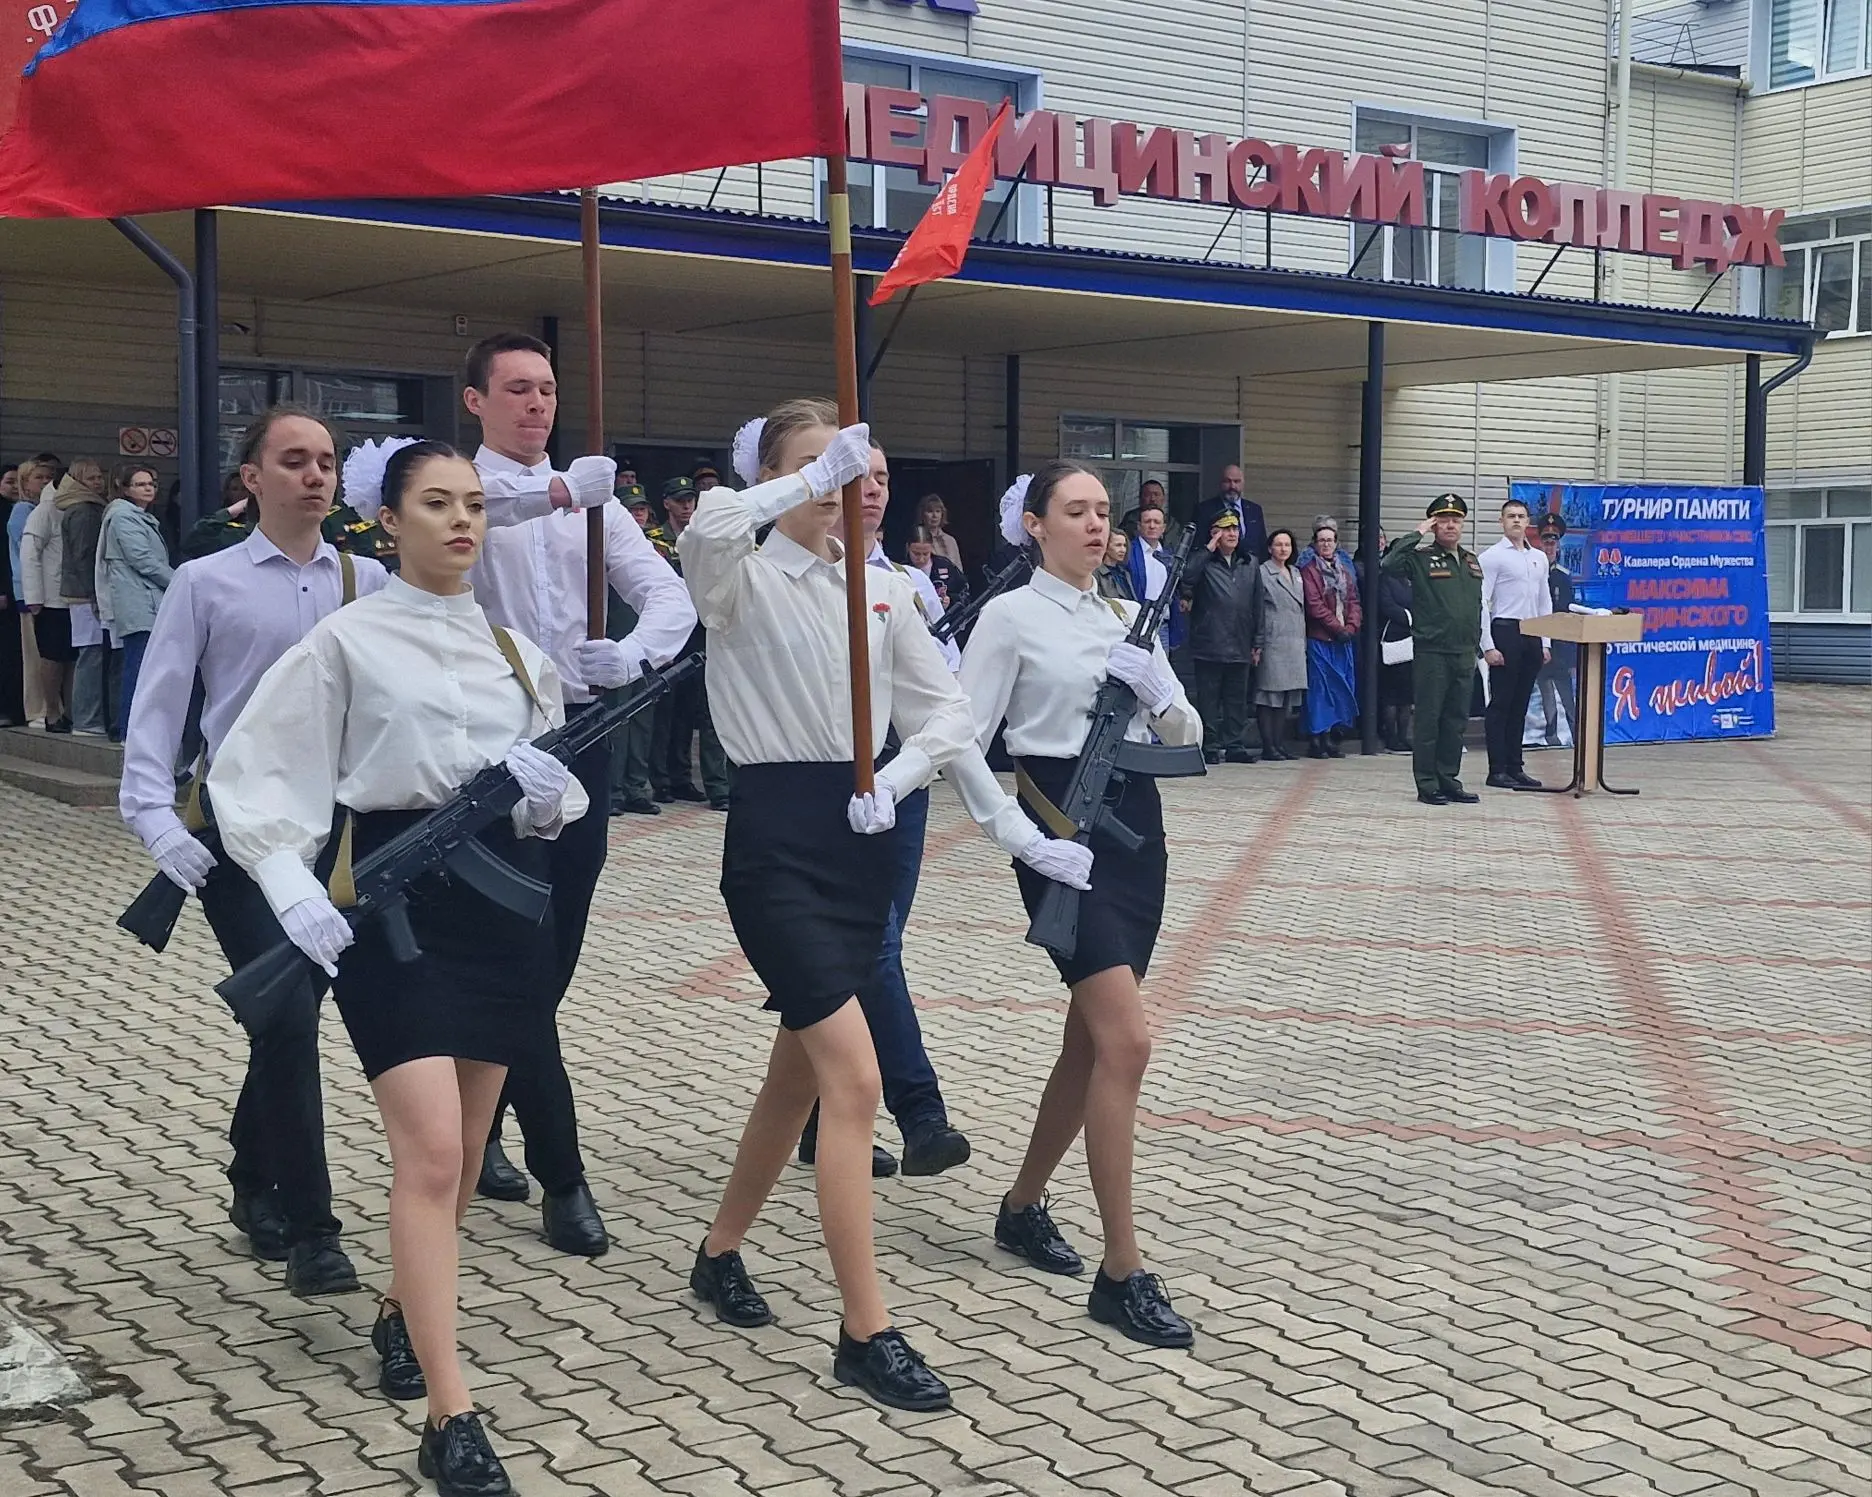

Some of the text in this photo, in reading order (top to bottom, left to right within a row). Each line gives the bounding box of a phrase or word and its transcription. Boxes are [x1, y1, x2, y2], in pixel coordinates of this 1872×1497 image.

[1460, 169, 1786, 273] КОЛЛЕДЖ
[1601, 498, 1751, 520] ТУРНИР ПАМЯТИ
[1624, 554, 1754, 570] Кавалера Ордена Мужества
[1626, 577, 1729, 600] МАКСИМА
[1629, 604, 1749, 633] ДИНСКОГО
[1615, 637, 1696, 655] тактической
[1698, 637, 1756, 653] медицине
[1612, 666, 1640, 722] Я
